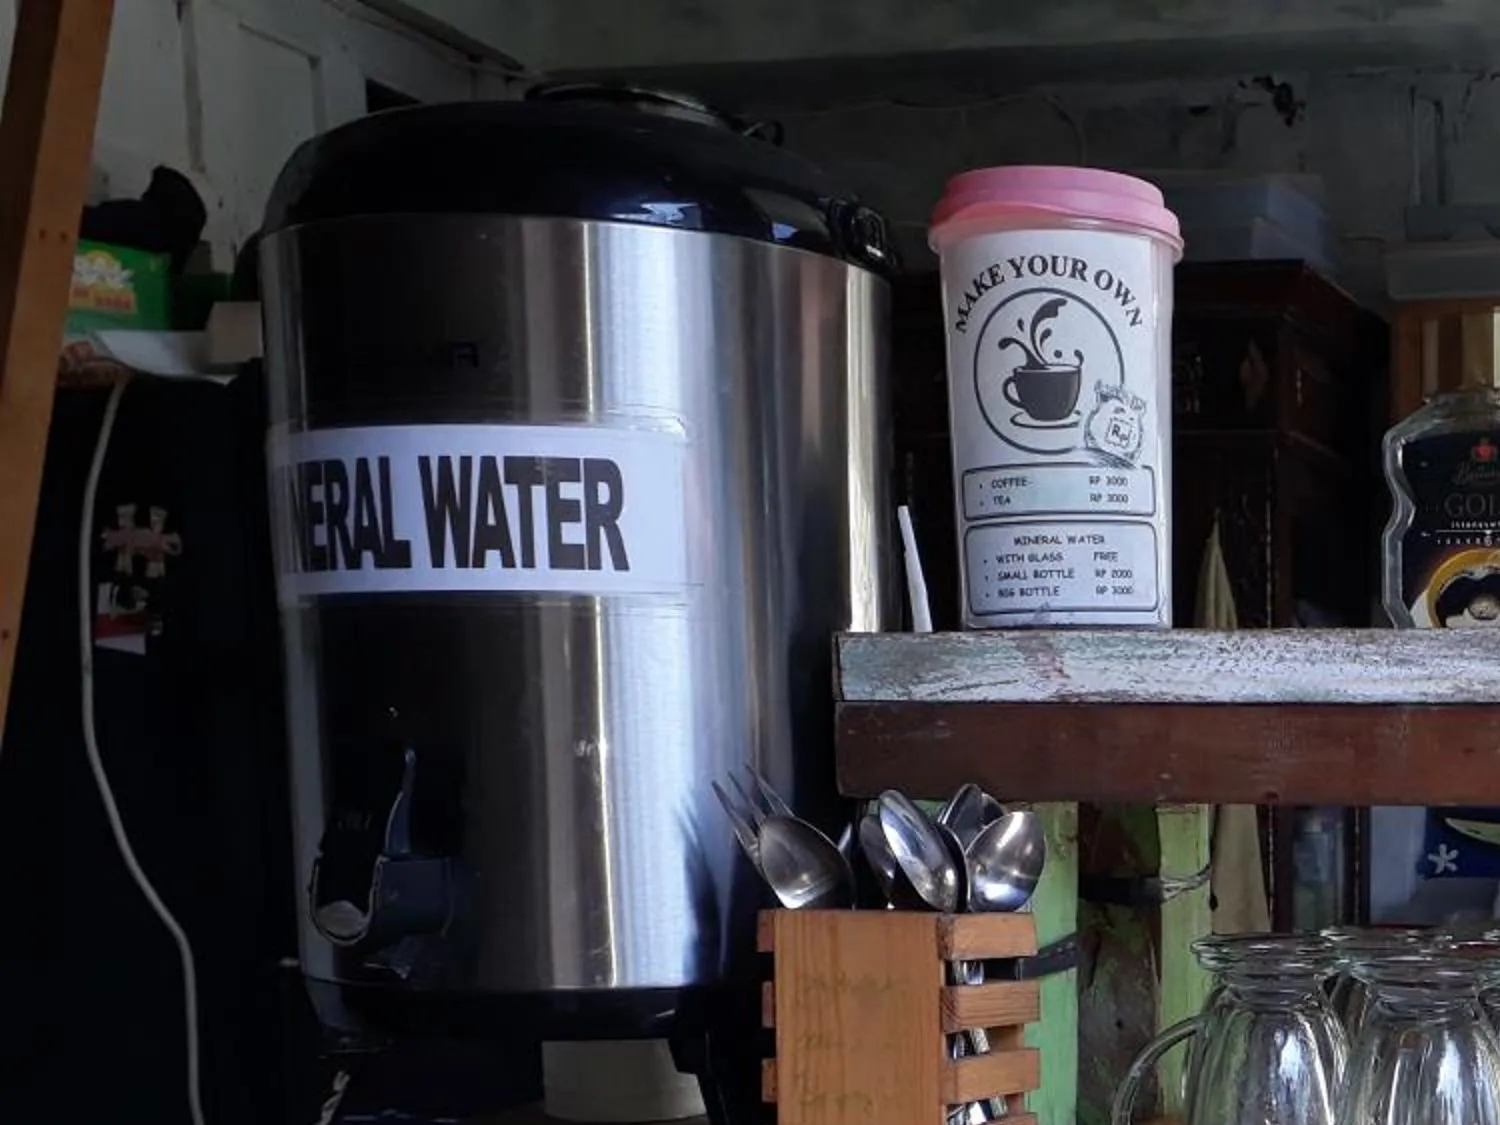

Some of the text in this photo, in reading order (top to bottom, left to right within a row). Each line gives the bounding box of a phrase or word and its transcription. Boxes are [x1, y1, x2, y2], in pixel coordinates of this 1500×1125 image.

[954, 254, 1143, 333] MAKE YOUR OWN
[991, 476, 1029, 489] COFFEE
[993, 495, 1011, 505] TEA
[417, 455, 630, 572] WATER
[1013, 534, 1105, 546] MINERAL WATER
[996, 551, 1064, 563] WITH GLASS
[1093, 551, 1119, 562] FREE
[997, 569, 1075, 581] SMALL BOTTLE
[1019, 586, 1061, 597] BOTTLE
